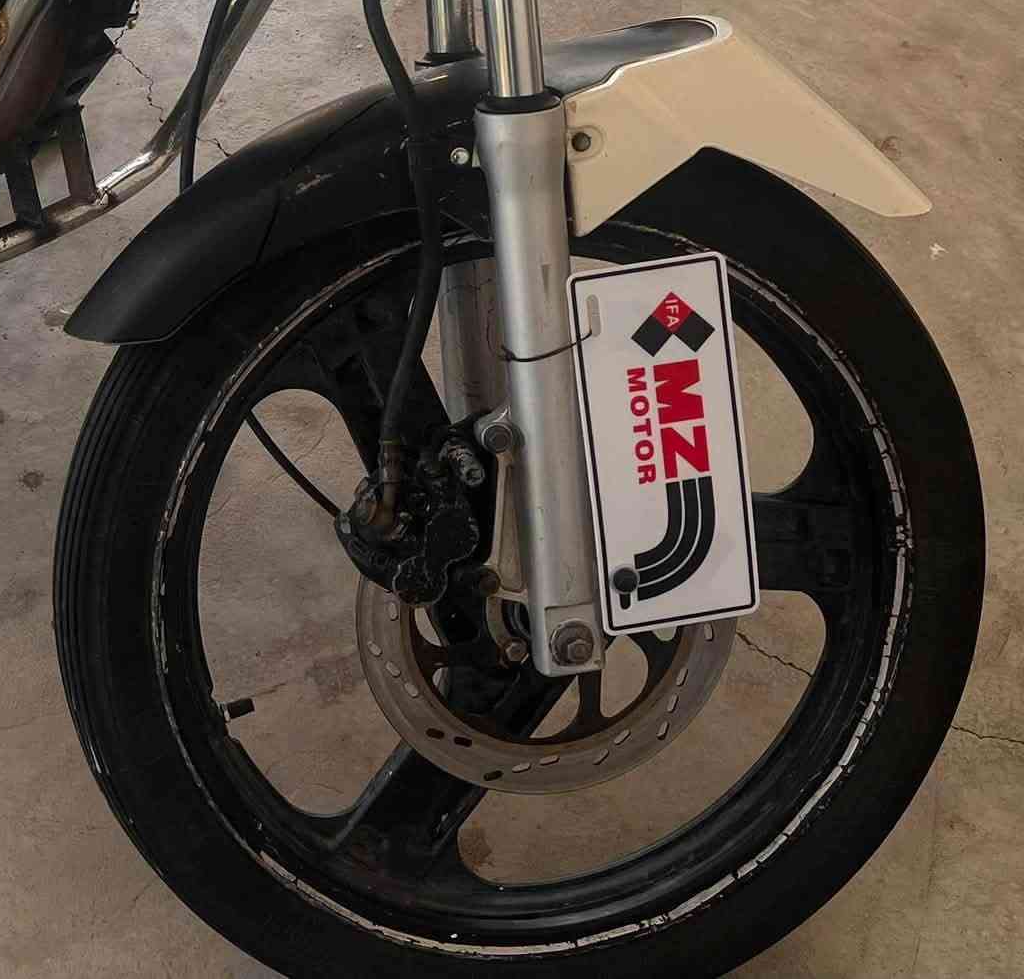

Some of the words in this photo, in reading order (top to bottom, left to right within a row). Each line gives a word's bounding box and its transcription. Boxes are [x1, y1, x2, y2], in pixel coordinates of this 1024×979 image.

[665, 298, 680, 328] IFA
[627, 367, 657, 485] MOTOR
[653, 359, 710, 479] MZ
